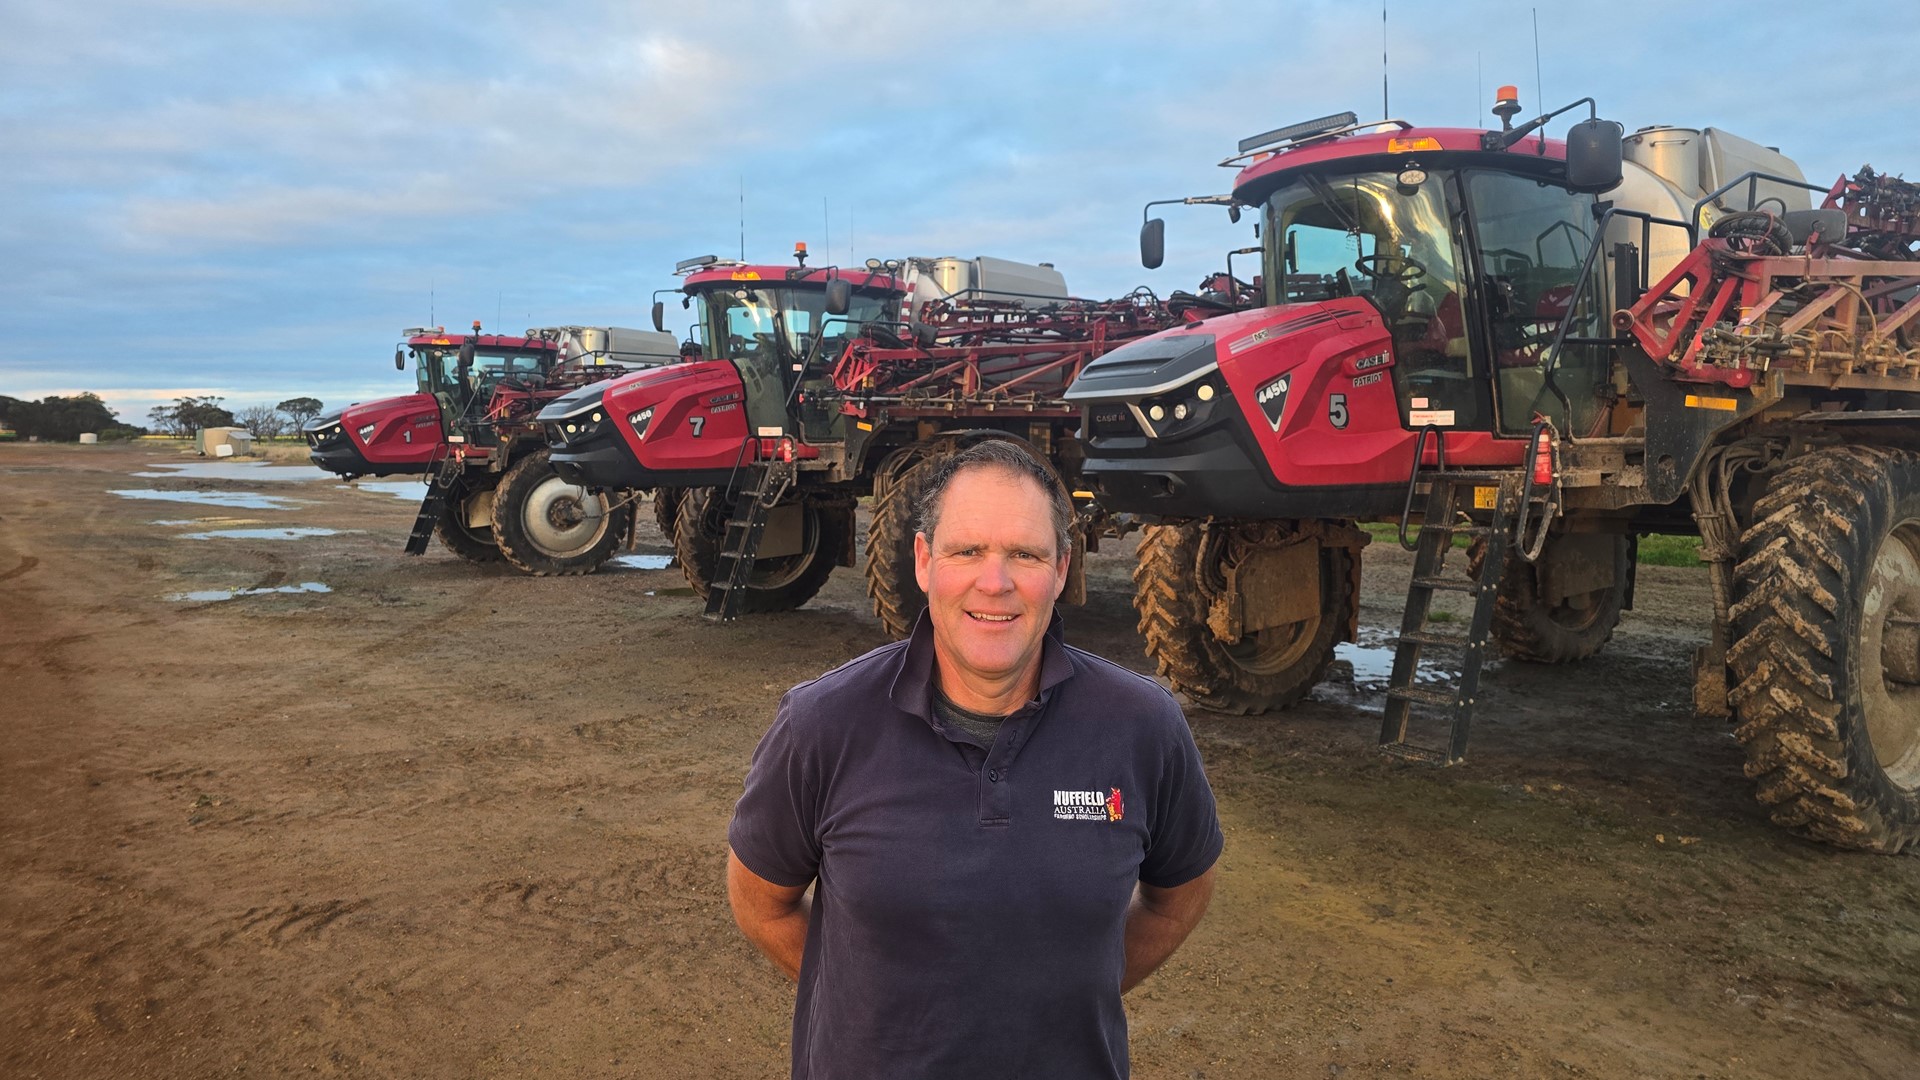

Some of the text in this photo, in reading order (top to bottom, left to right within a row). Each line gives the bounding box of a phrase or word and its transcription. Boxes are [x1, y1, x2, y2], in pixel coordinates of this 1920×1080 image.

[1356, 355, 1382, 370] CASE
[1353, 371, 1383, 388] PATRIOT
[1258, 379, 1288, 403] 4450
[631, 409, 652, 424] 4450
[1096, 414, 1117, 422] CASE
[1329, 394, 1349, 429] 5
[689, 416, 705, 437] 7
[403, 430, 412, 444] 1
[1053, 790, 1105, 806] NUFFIELD
[1054, 806, 1106, 814] AUSTRALIA
